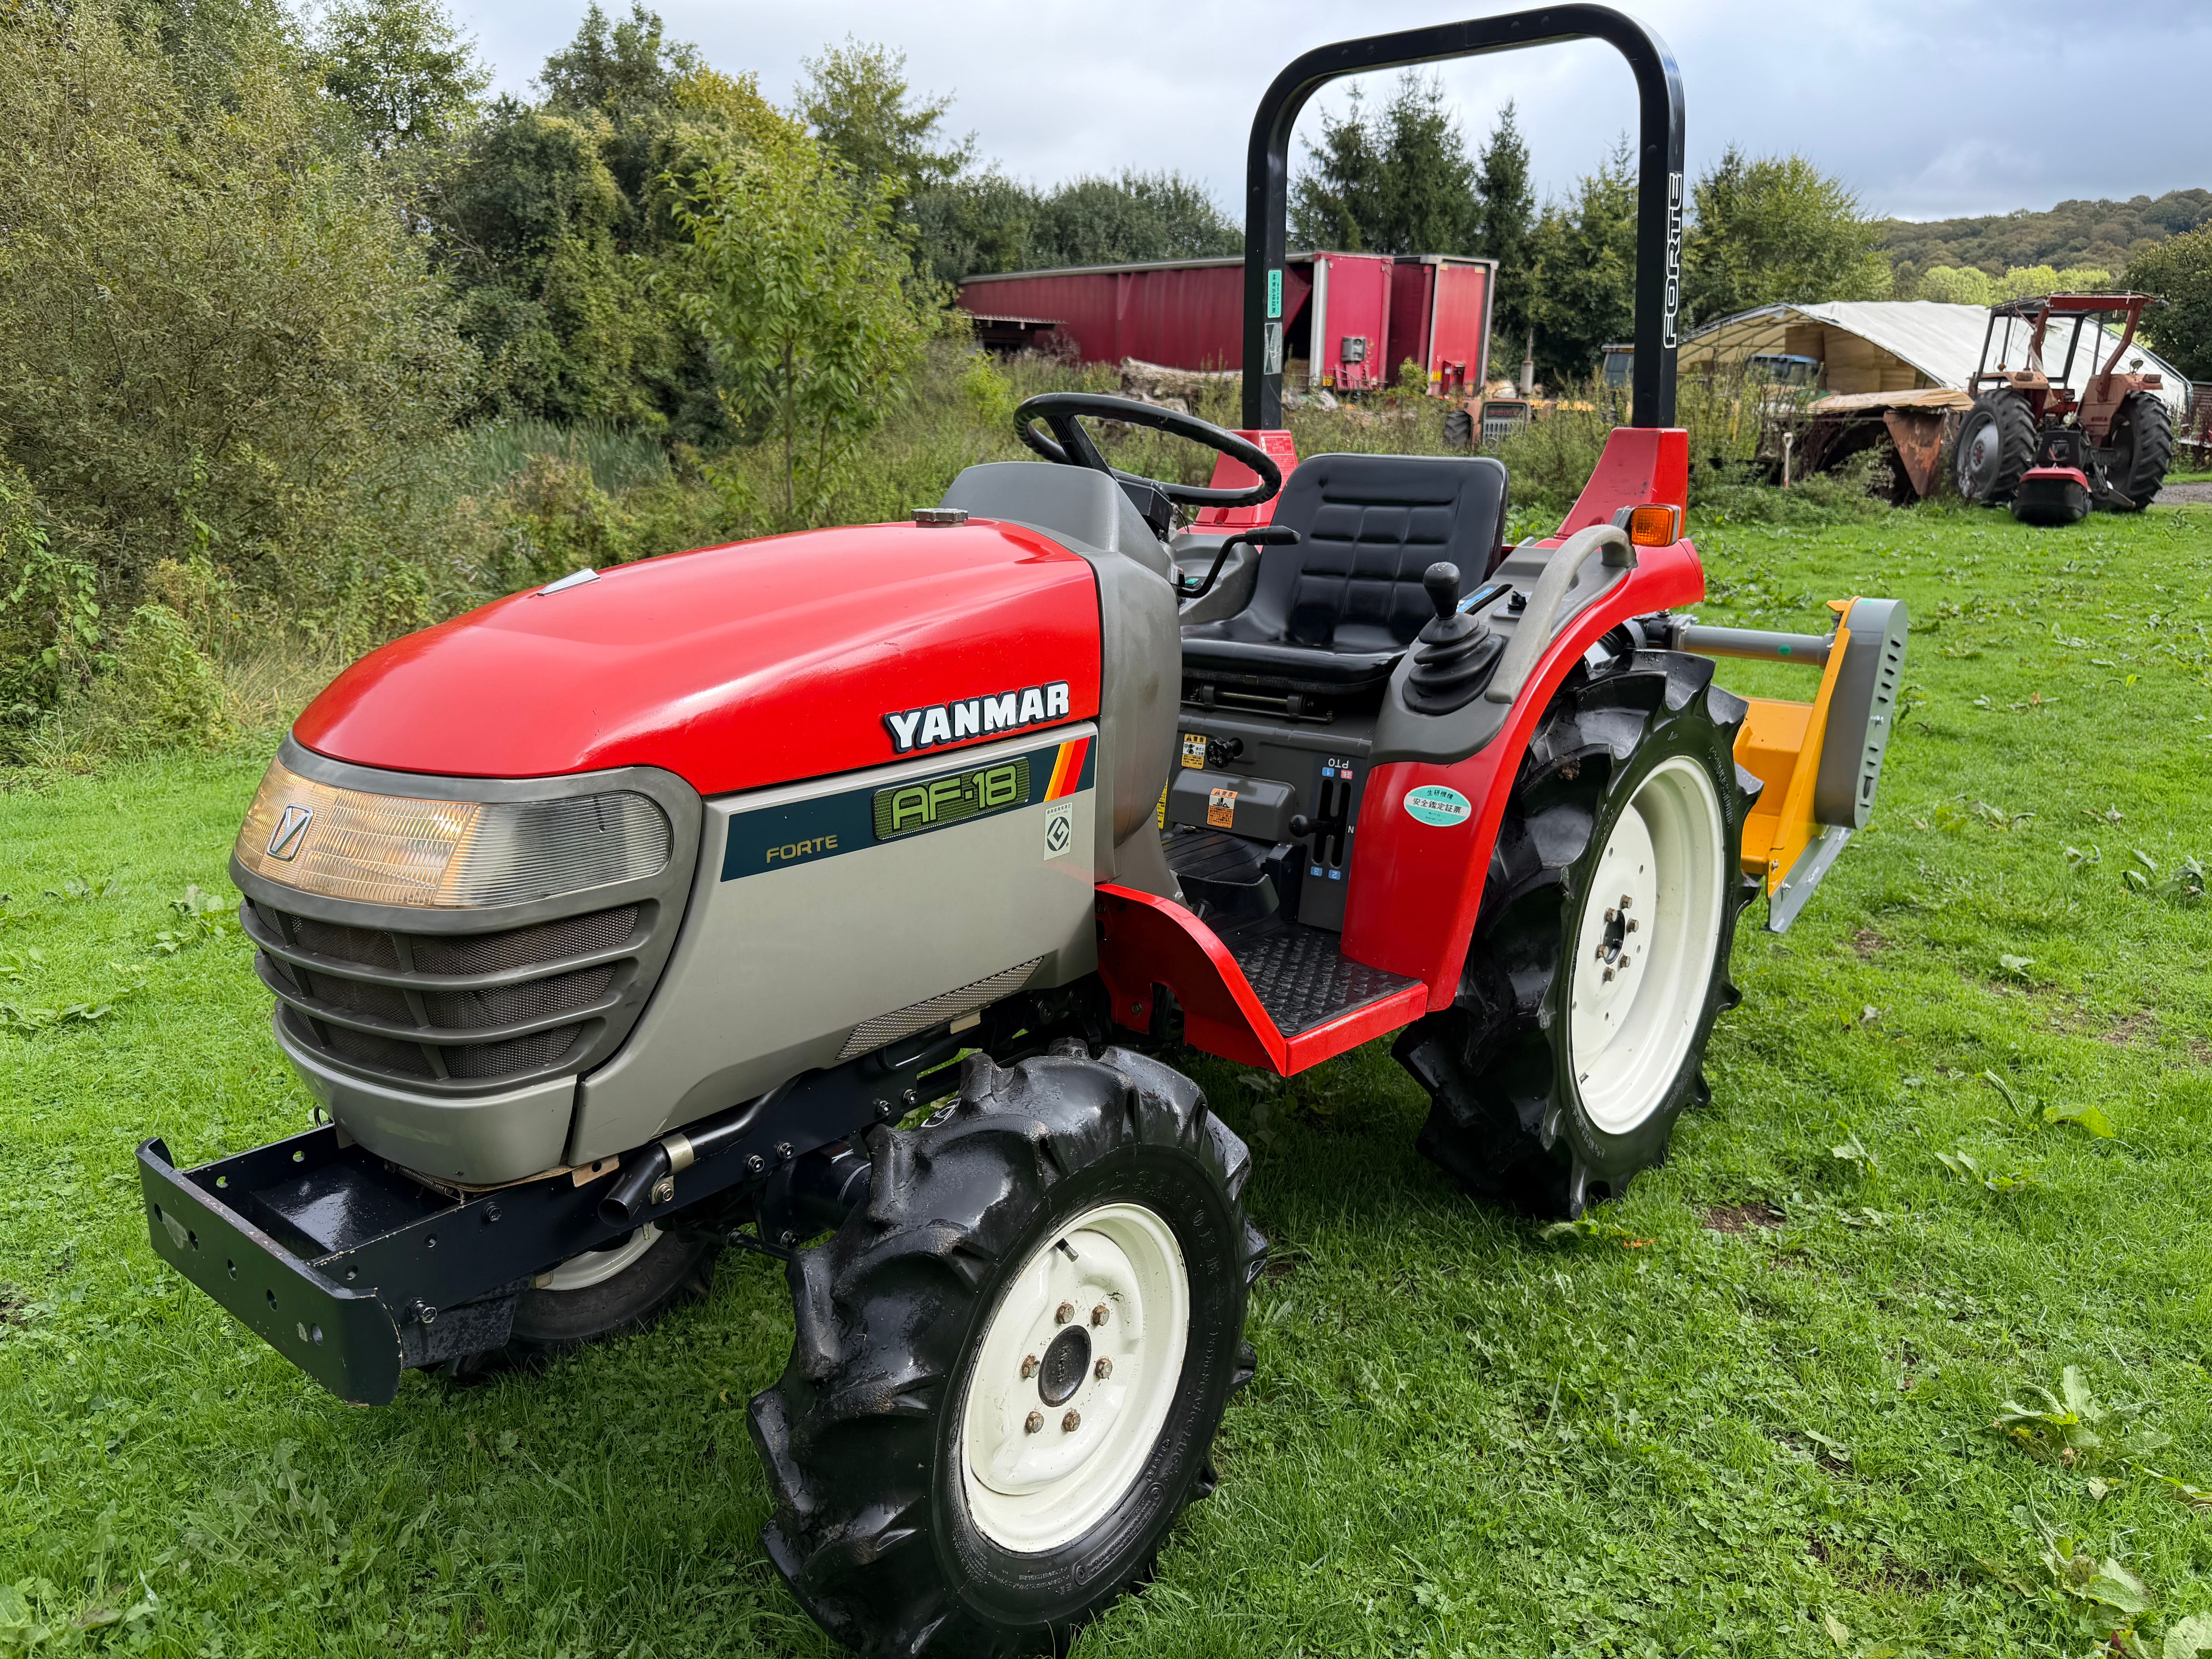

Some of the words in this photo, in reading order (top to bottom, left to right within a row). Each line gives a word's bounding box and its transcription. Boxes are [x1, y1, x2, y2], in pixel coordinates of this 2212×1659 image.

[1663, 172, 1683, 349] FORTE
[887, 682, 1069, 750] YANMAR
[1328, 758, 1349, 769] PTO
[1426, 789, 1454, 800] 生研機構
[1413, 798, 1462, 814] 安全鑑定証票
[766, 834, 838, 863] FORTE
